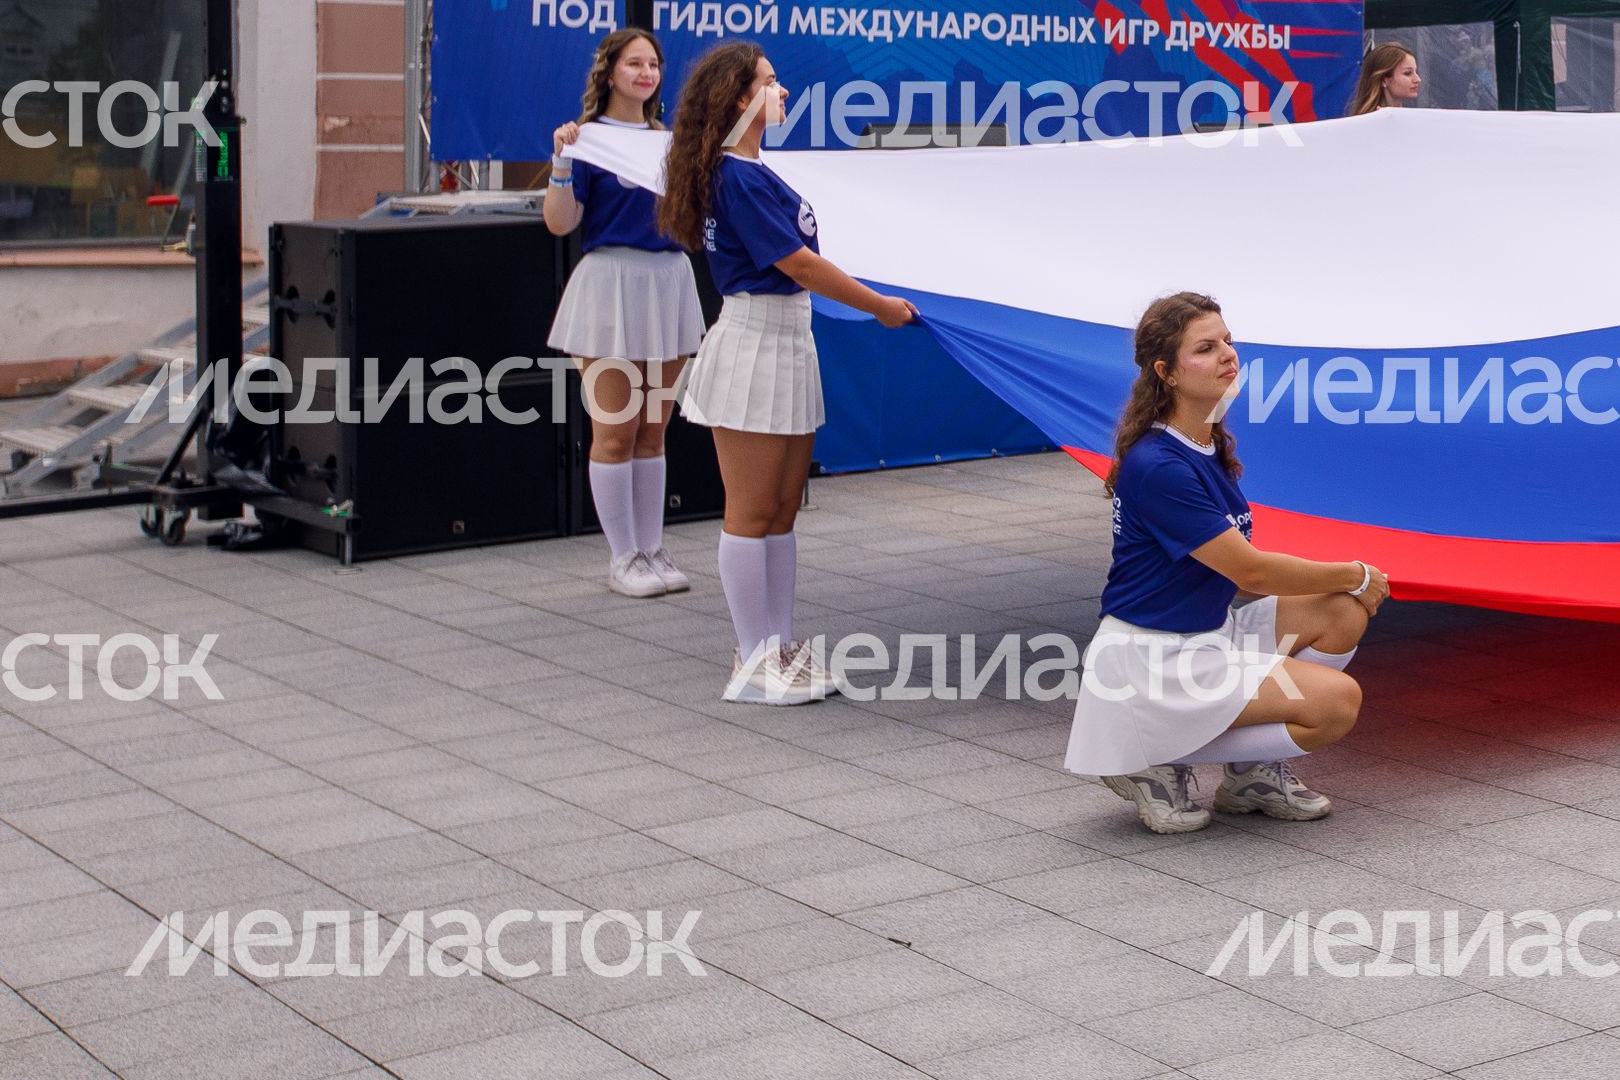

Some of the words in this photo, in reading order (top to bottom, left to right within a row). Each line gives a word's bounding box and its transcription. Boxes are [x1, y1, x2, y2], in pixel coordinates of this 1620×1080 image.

[788, 6, 1096, 47] МЕЖДУНАРОДНЫХ
[1104, 17, 1160, 47] ИГР
[1165, 19, 1291, 51] ДРУЖБЫ
